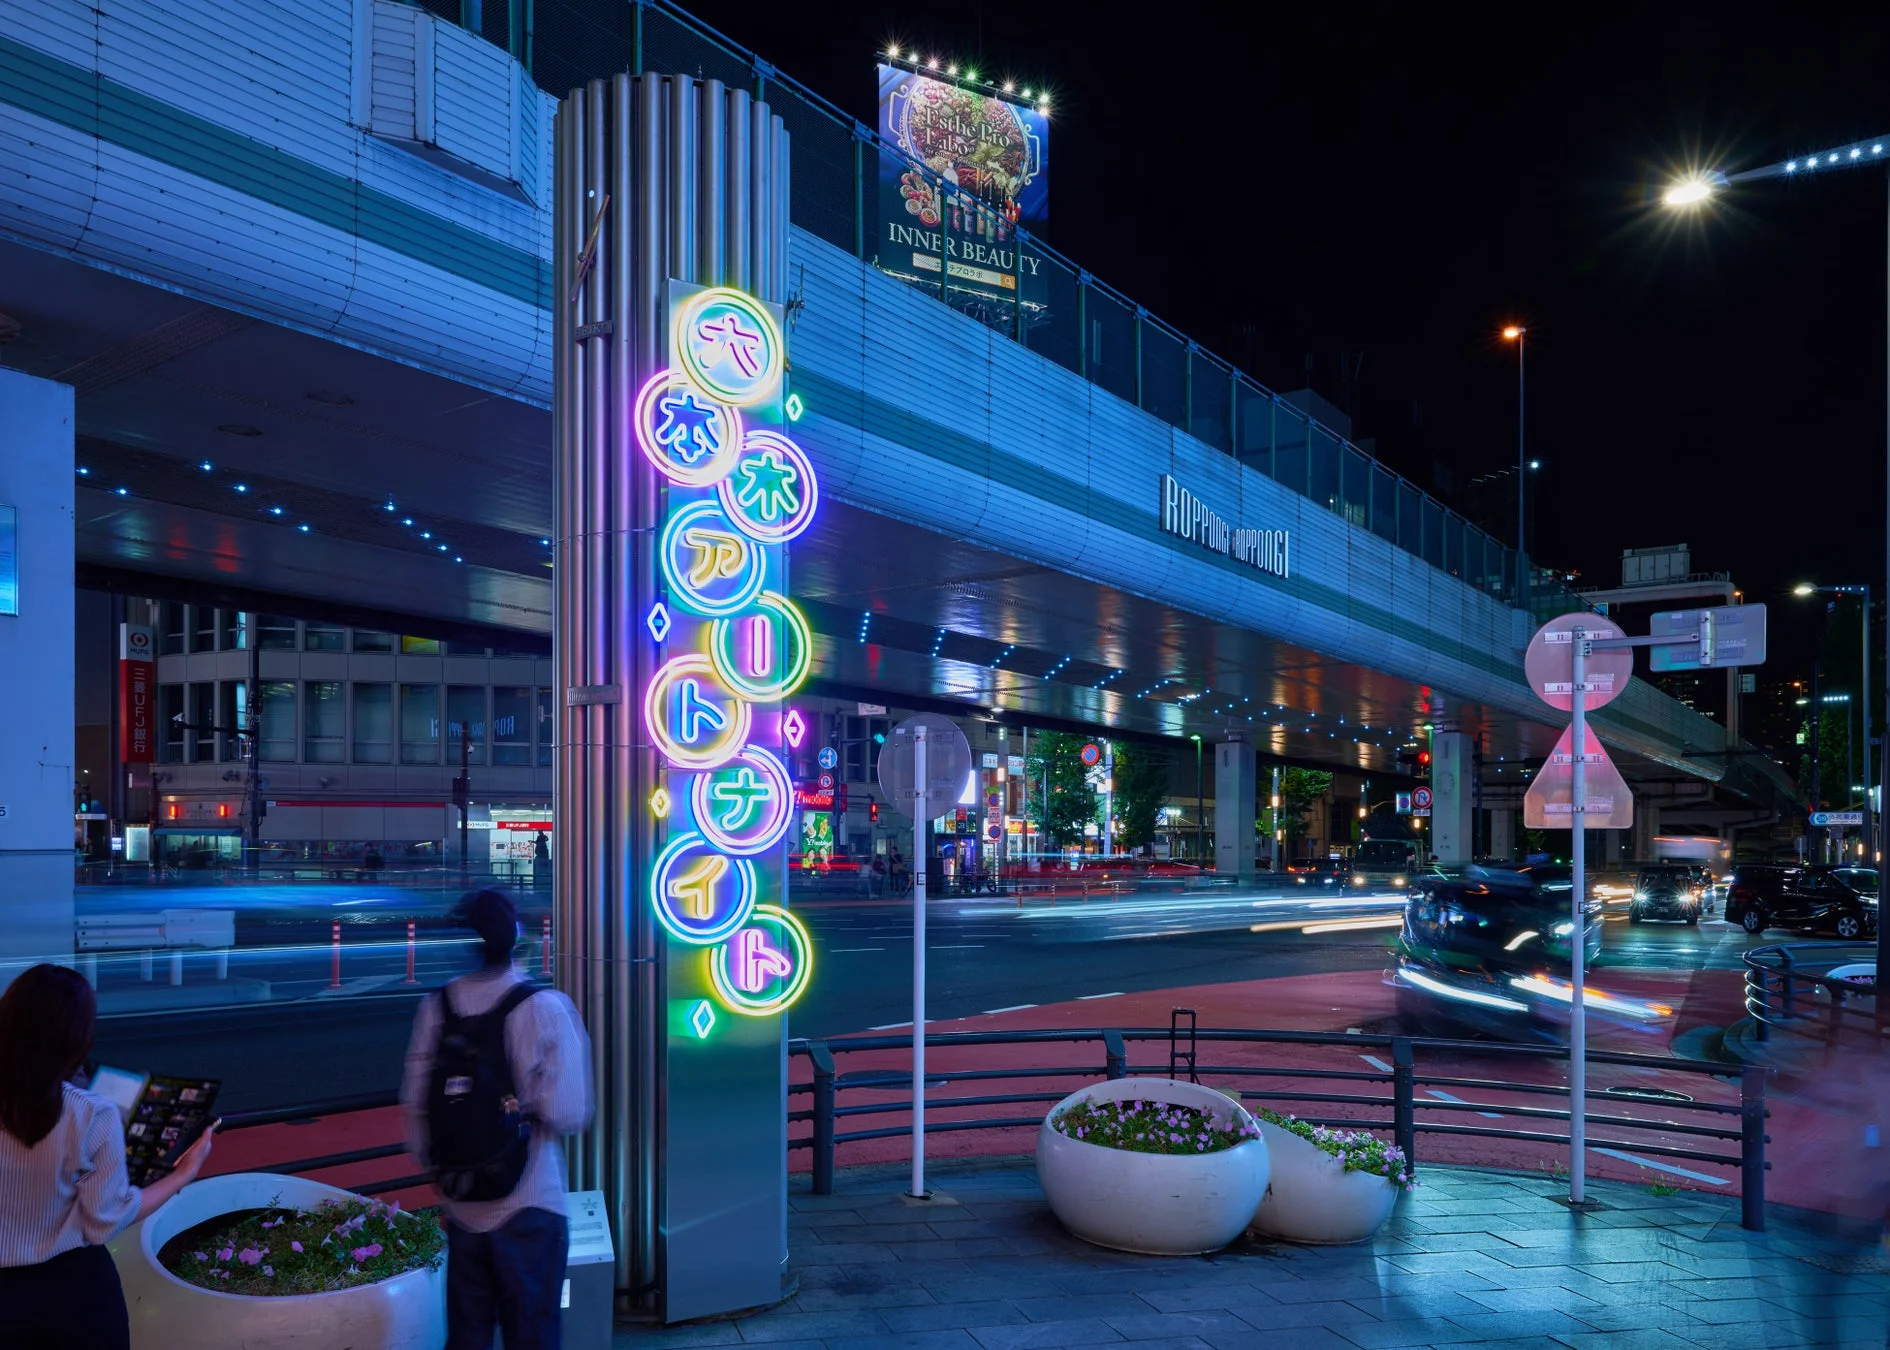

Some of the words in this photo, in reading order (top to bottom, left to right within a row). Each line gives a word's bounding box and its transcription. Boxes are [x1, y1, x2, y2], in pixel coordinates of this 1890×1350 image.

[926, 105, 977, 137] Esthe
[981, 122, 1011, 148] Pro
[926, 127, 968, 155] Labo
[888, 222, 958, 257] INNER
[961, 240, 1042, 276] BEAUTY
[934, 261, 984, 279] エテプロラボ
[1165, 473, 1230, 555] ROPPONGI
[1235, 528, 1289, 579] ROPPONGI
[134, 667, 146, 753] 三菱UFJ銀行
